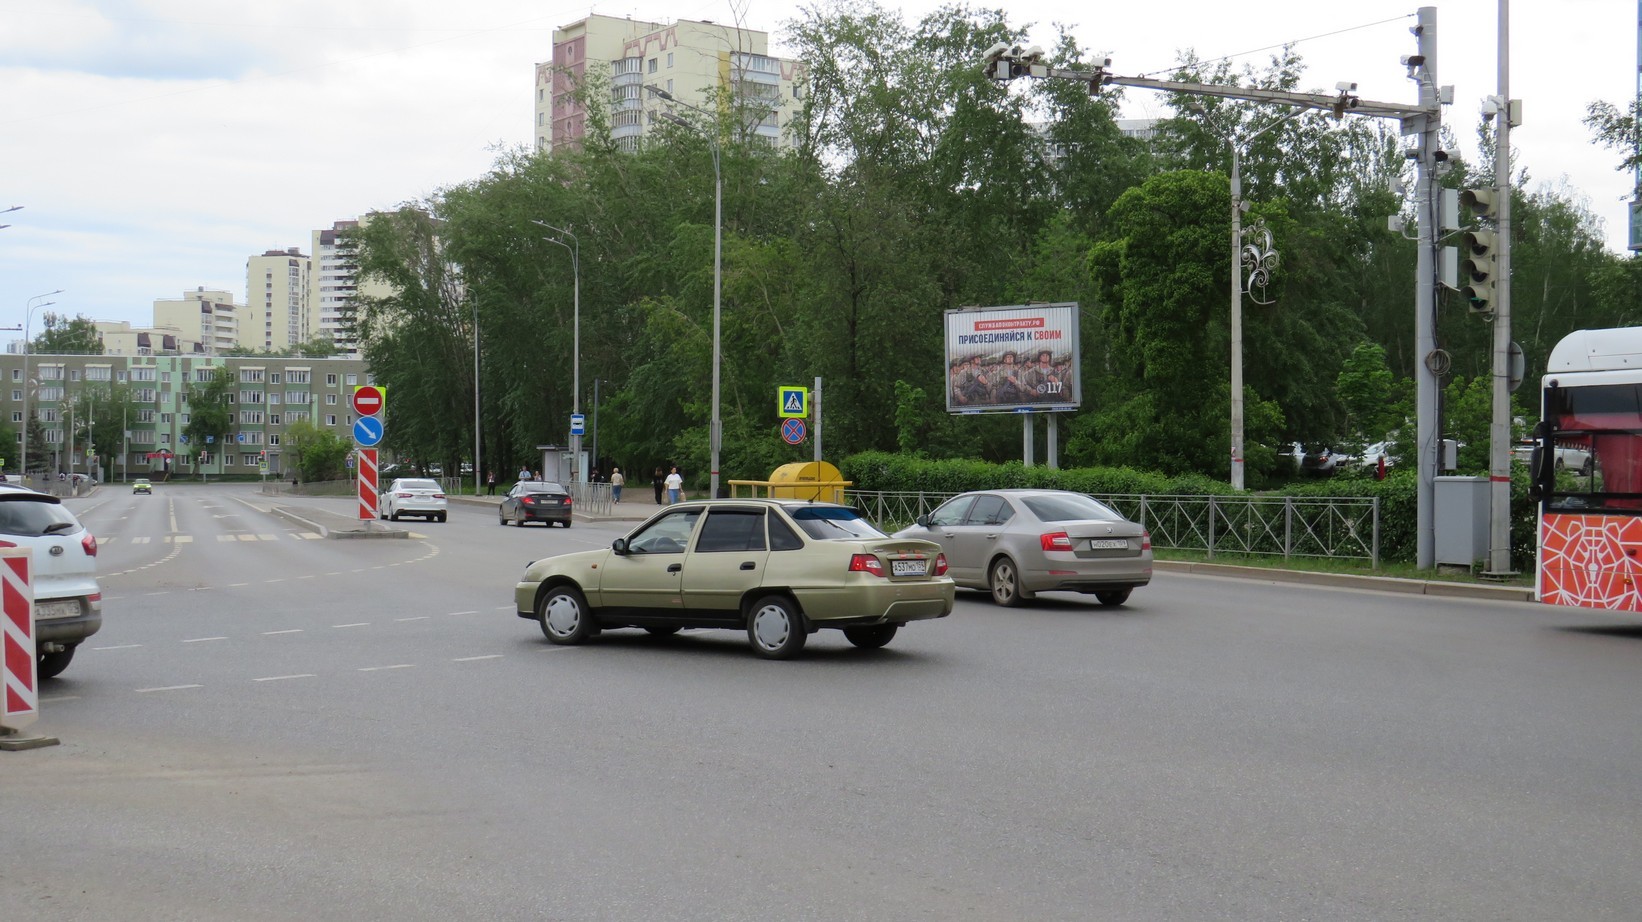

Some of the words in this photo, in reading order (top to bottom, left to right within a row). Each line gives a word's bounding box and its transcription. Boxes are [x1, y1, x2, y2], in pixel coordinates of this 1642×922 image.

[978, 320, 1040, 329] СЛУЖБАПОКОНТРАКТУ.РФ
[958, 330, 1025, 344] ПРИСОЕДИНЯЙСЯ
[1027, 331, 1032, 341] К
[1034, 330, 1062, 340] СВОИМ
[1047, 382, 1062, 393] 117
